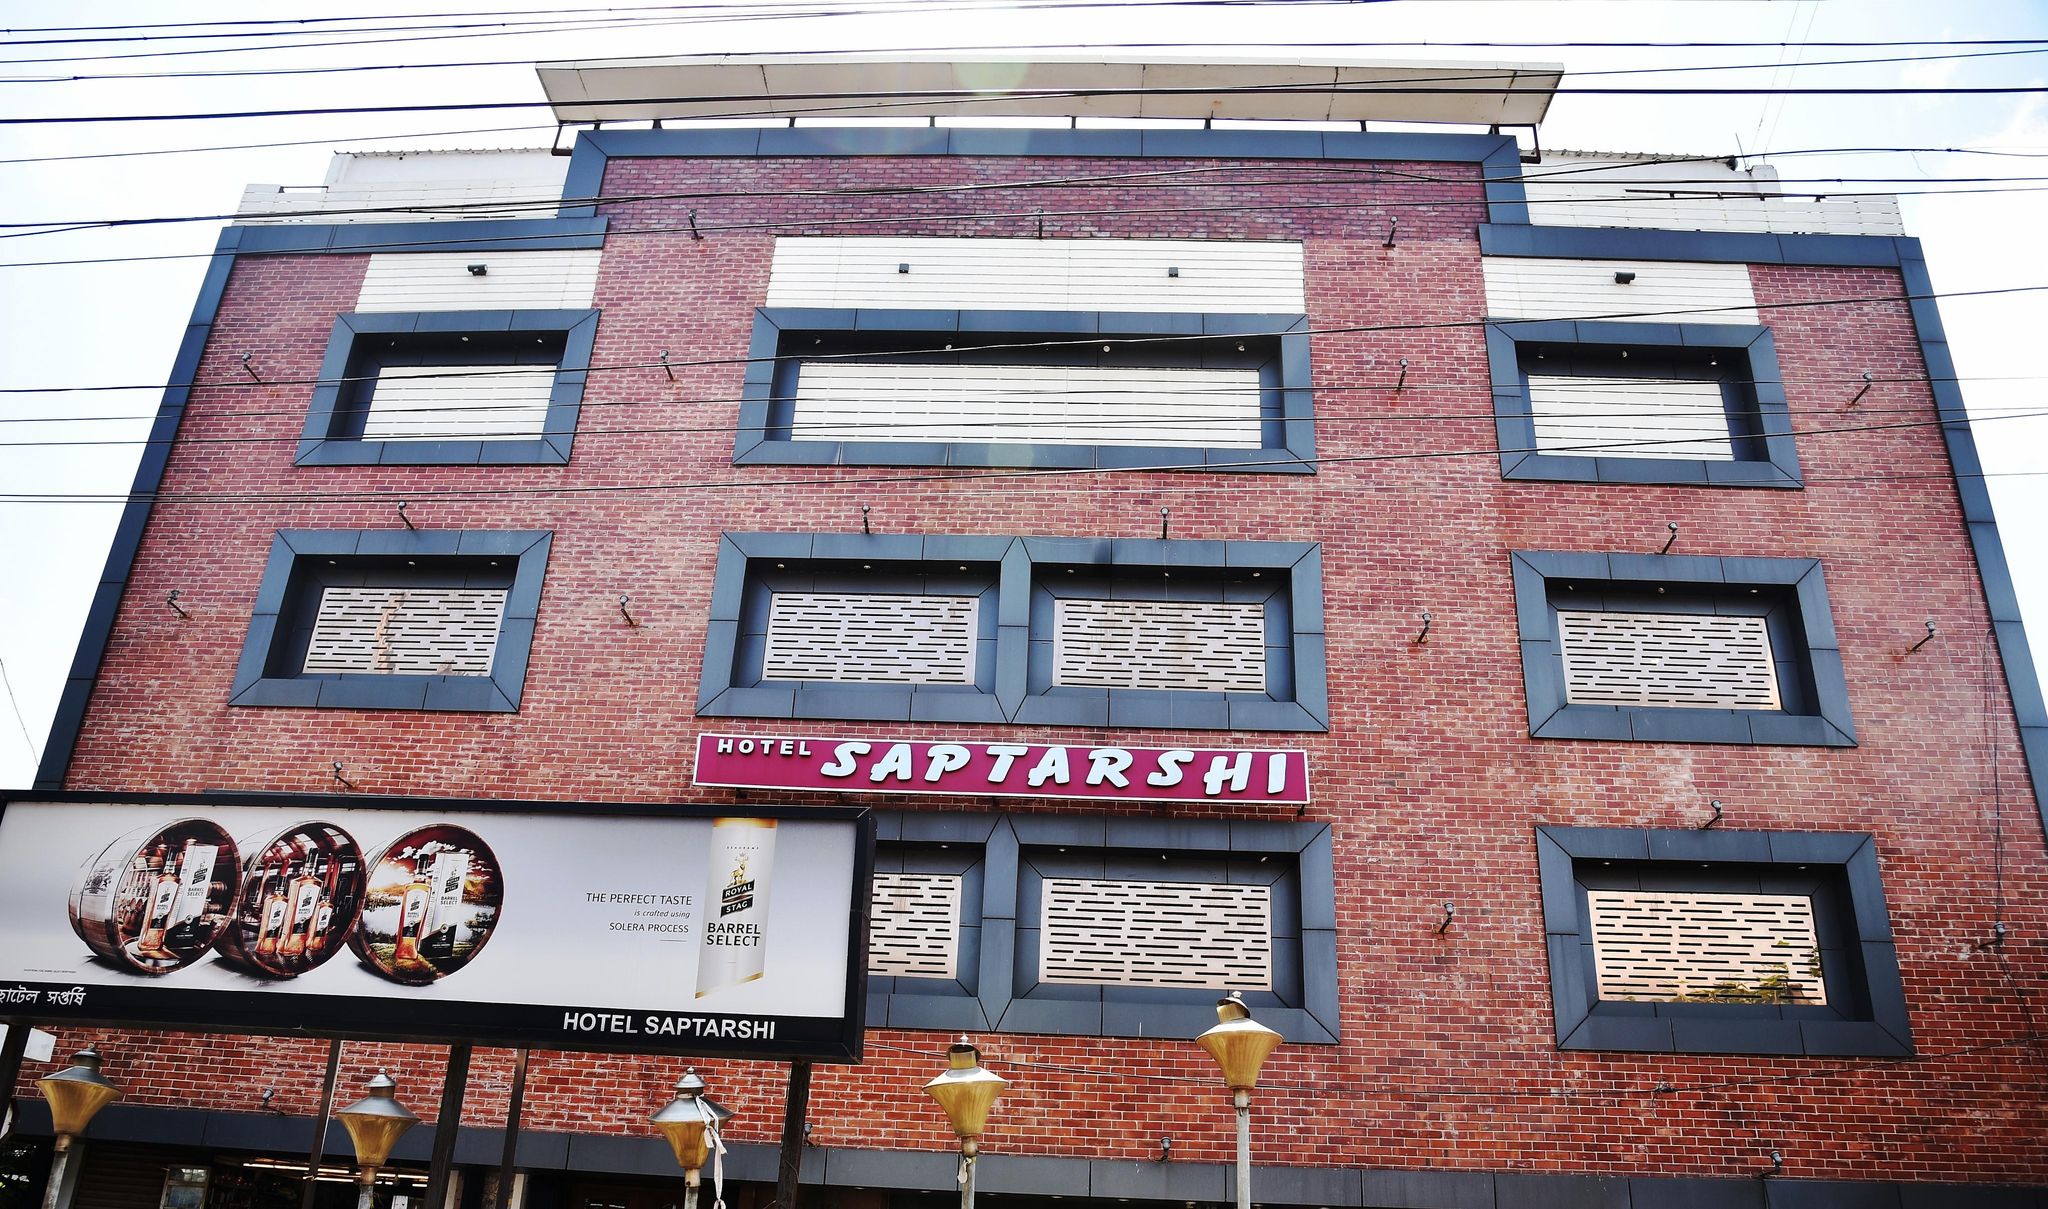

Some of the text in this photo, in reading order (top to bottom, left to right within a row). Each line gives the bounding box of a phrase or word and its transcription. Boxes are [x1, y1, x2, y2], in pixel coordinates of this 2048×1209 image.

[717, 738, 1288, 795] HOTEL SAPTARSHI
[725, 883, 752, 897] ROYAL
[586, 892, 693, 906] THE PERFECT TASTE
[725, 901, 748, 913] STAG
[634, 909, 691, 920] is crafted using
[609, 922, 689, 934] SOLERA PROCESS
[707, 922, 761, 935] BARREL
[706, 934, 760, 947] SELECT
[47, 986, 87, 1006] সপ্তর্ষি
[563, 1011, 776, 1040] HOTEL SAPTARSHI
